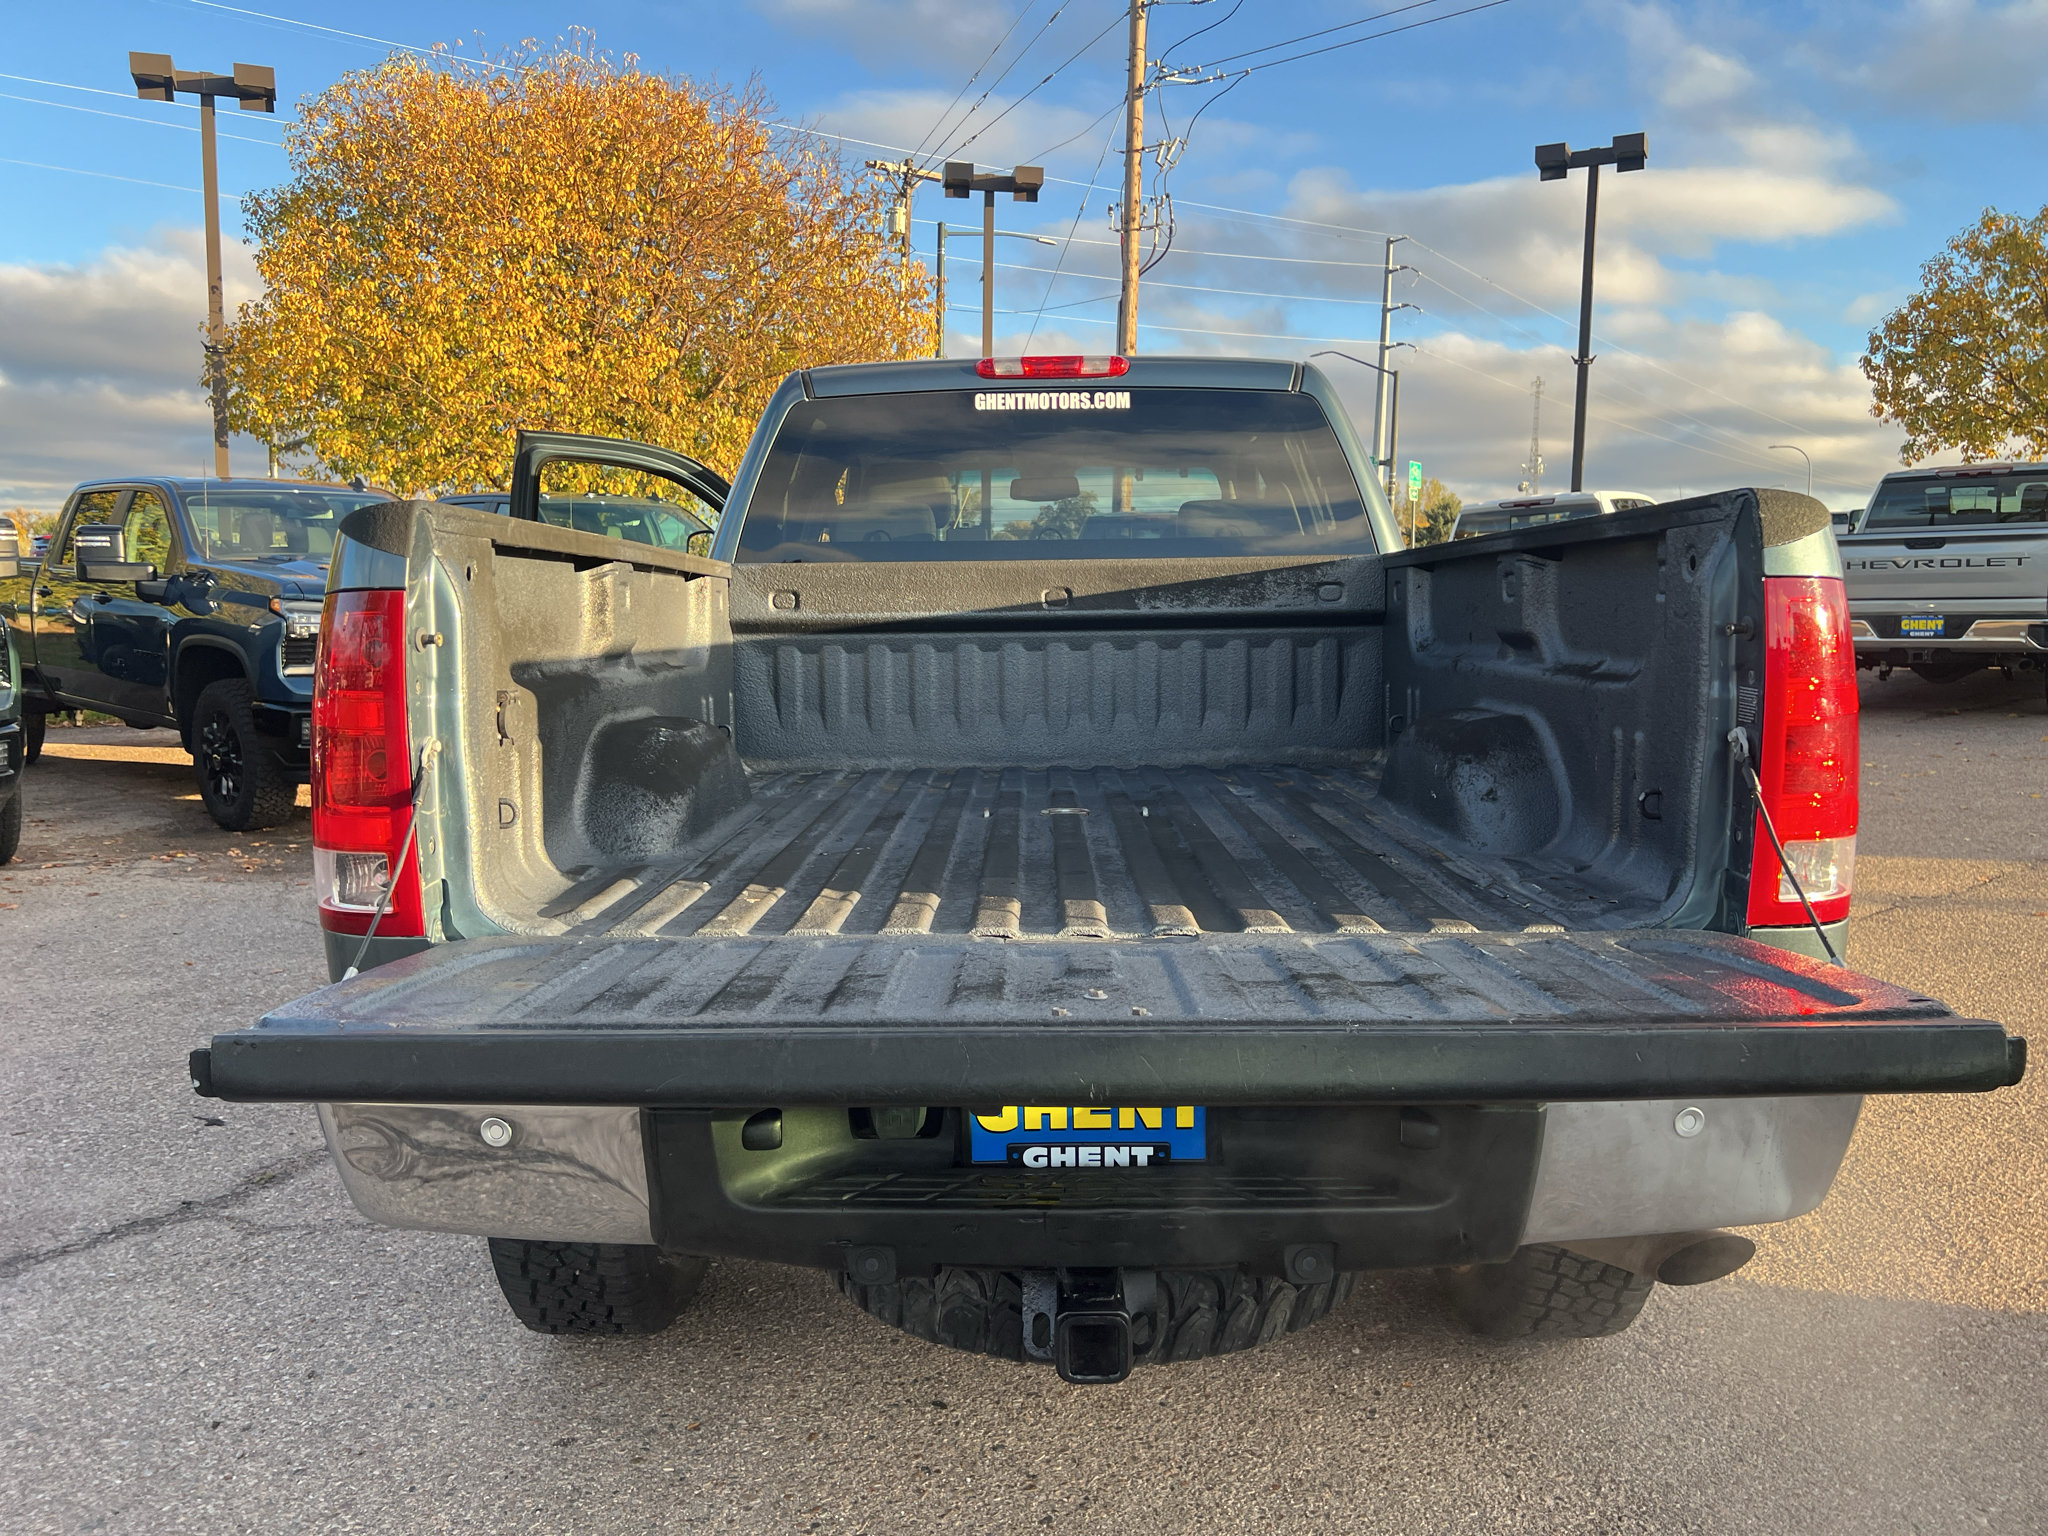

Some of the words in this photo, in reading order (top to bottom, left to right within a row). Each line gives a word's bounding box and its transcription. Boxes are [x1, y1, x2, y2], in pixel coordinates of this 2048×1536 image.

[974, 391, 1131, 411] GHENTMOTORS.COM
[1846, 556, 2031, 570] HEVROLET
[1901, 619, 1944, 631] GHENT
[1022, 1146, 1154, 1169] GHENT
